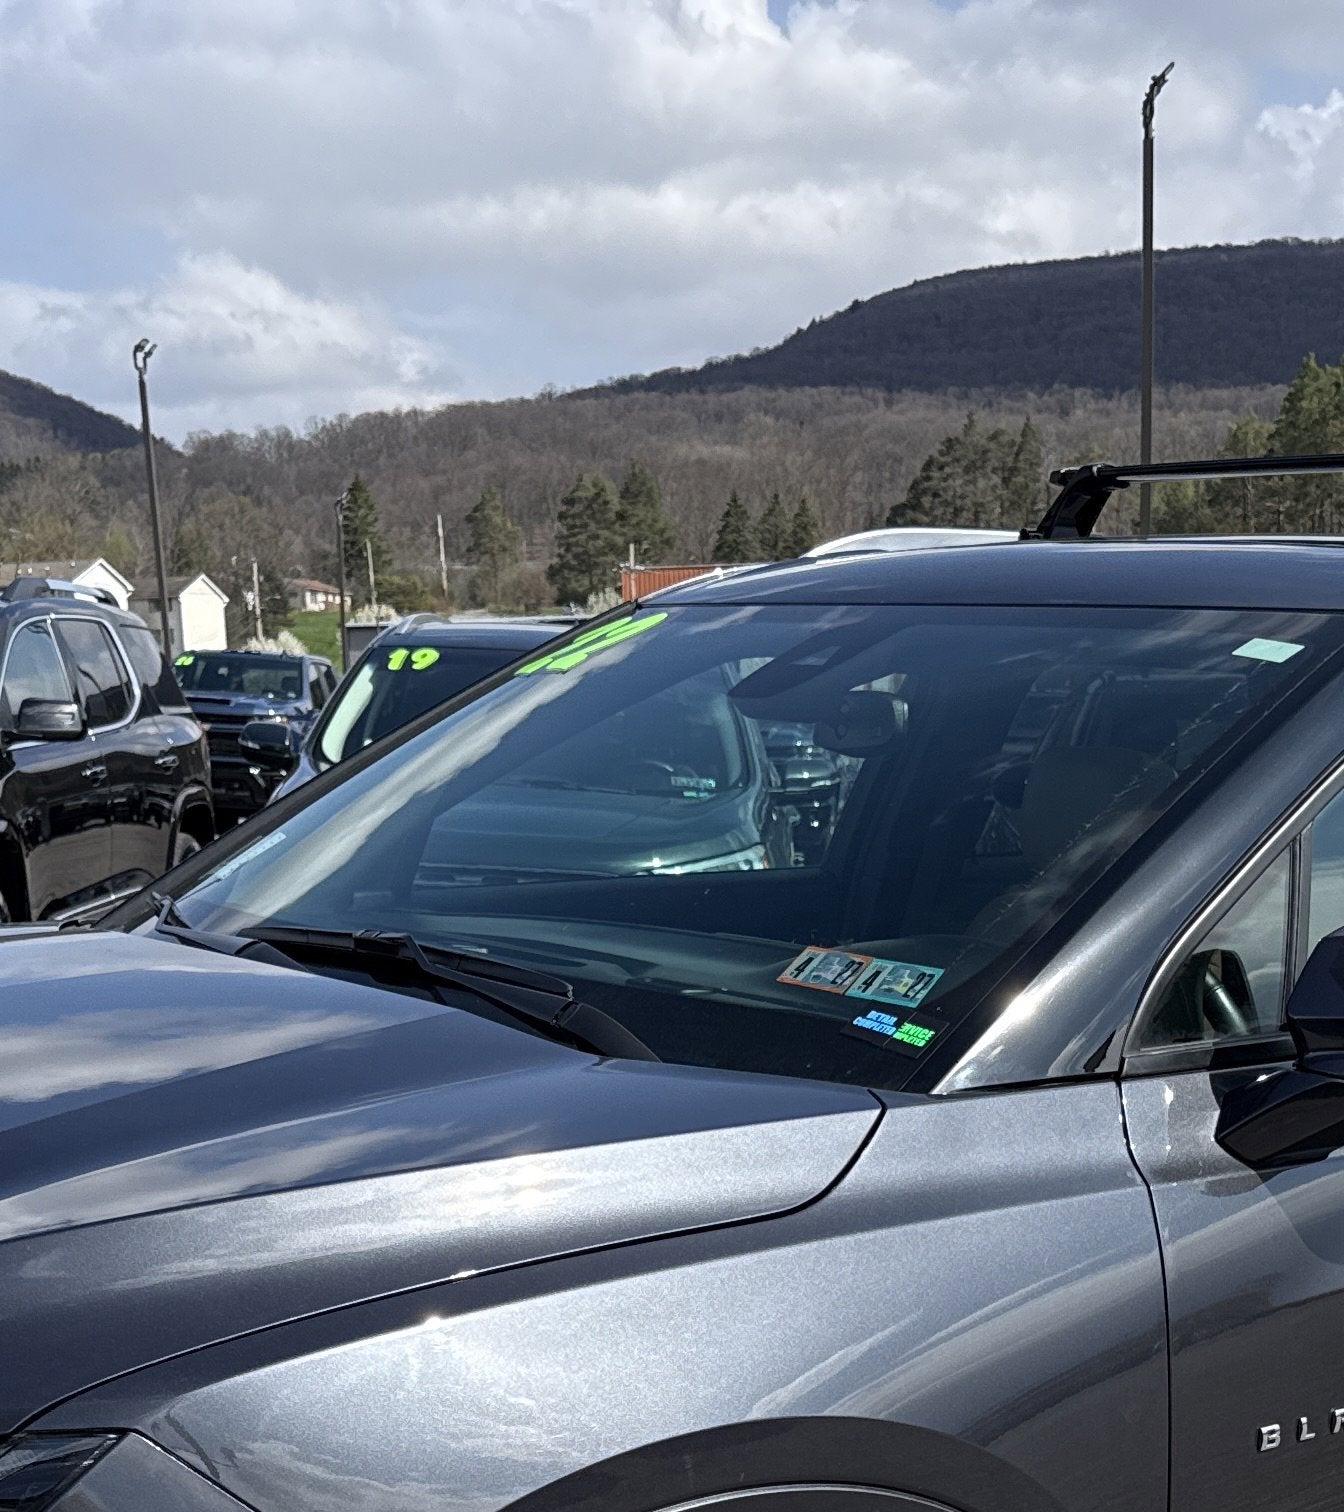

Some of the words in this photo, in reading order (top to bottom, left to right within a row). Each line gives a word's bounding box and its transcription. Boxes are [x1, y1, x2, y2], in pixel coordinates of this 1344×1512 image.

[387, 648, 441, 671] 19
[793, 956, 815, 979] 4
[861, 970, 882, 993] 4
[902, 973, 936, 999] 27
